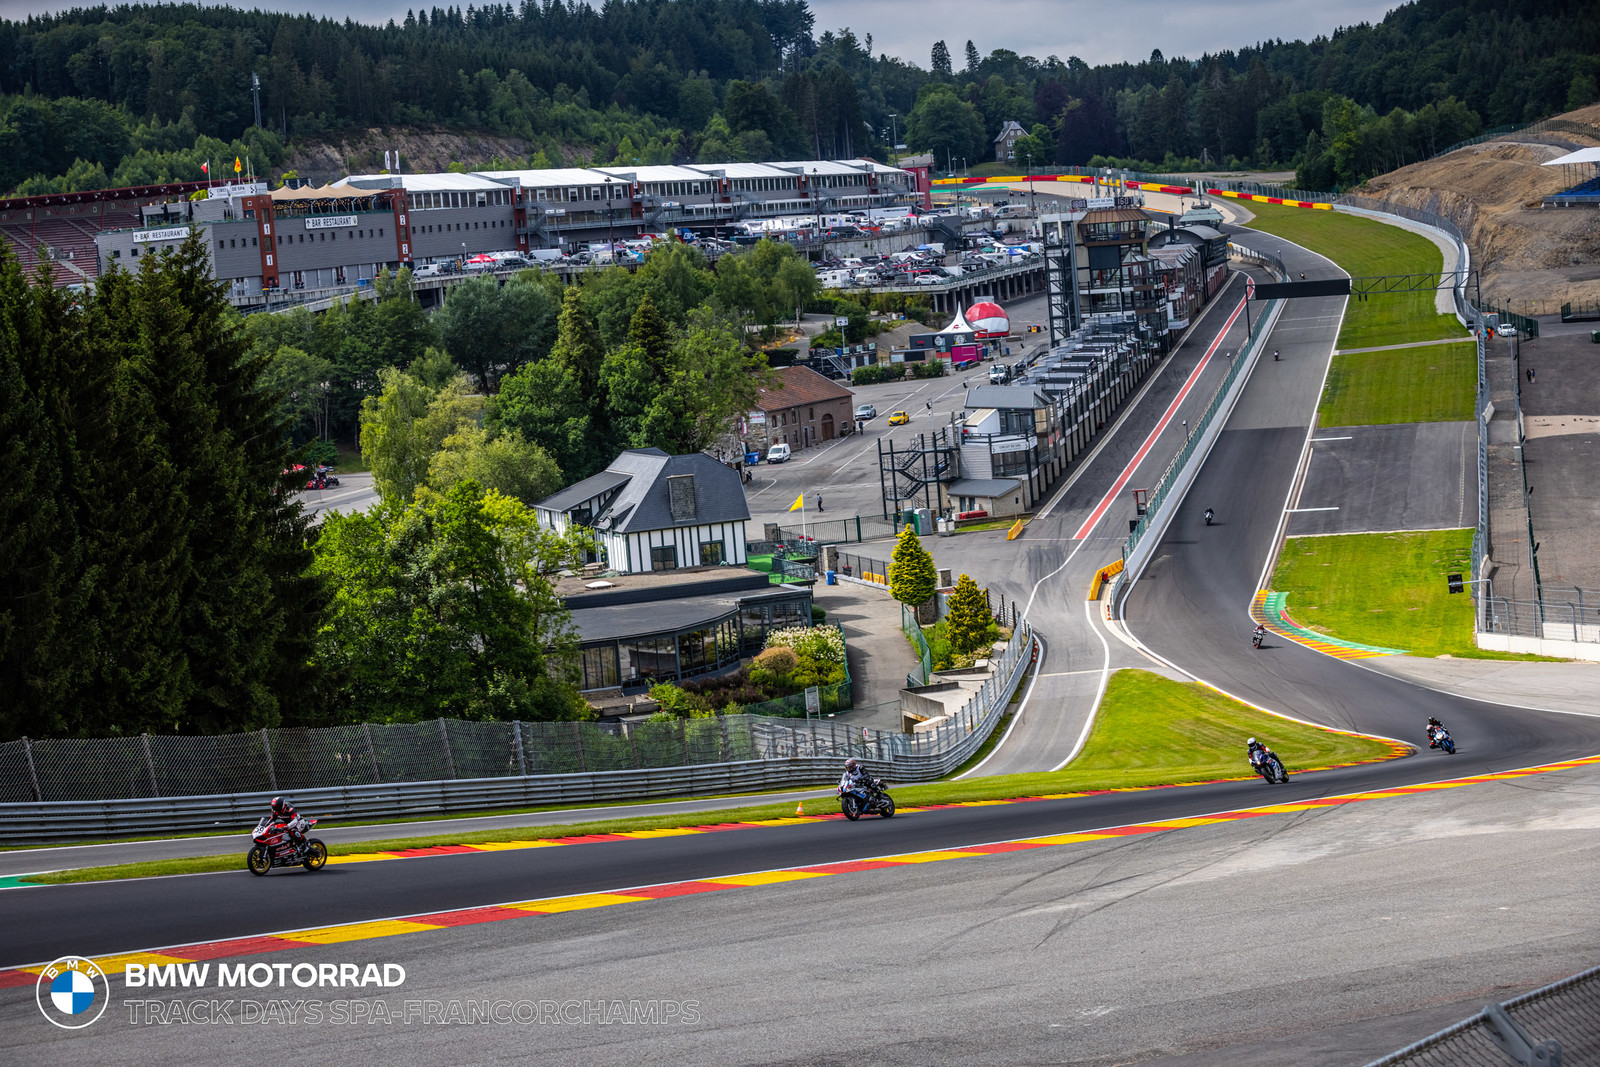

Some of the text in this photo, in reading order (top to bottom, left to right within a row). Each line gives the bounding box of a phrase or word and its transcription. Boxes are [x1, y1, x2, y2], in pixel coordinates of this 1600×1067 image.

[311, 216, 351, 227] BAR RESTAURANT
[152, 230, 183, 238] RESTAURANT
